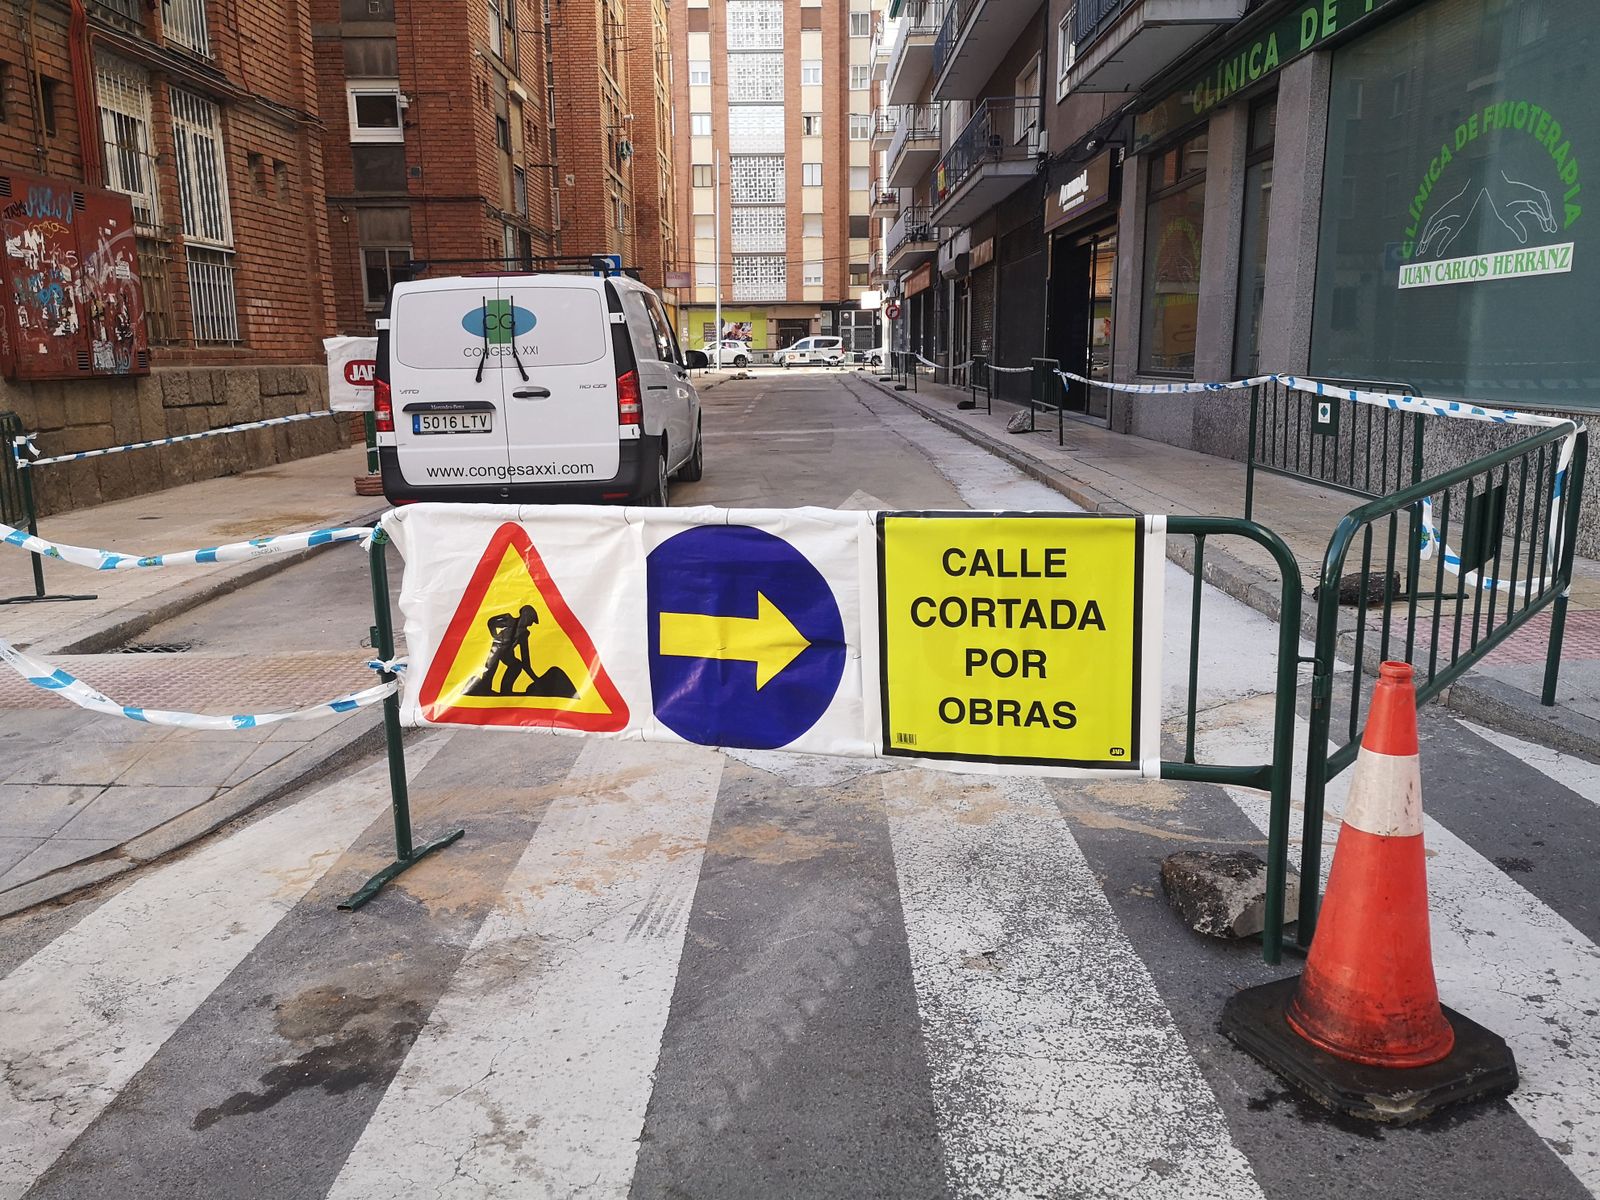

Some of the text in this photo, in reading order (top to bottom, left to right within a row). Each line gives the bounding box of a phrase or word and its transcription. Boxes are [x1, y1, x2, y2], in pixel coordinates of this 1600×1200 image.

[1193, 0, 1337, 114] CLÍNICA DE
[1455, 113, 1480, 151] DE
[1483, 101, 1582, 230] FISIOTERAPIA
[1400, 246, 1571, 286] JUAN CARLOS HERRANZ
[484, 313, 515, 330] CG
[522, 345, 539, 355] XXI
[423, 416, 457, 429] 5016
[462, 415, 487, 428] LTV
[426, 462, 594, 479] www.congesaxxi.com
[942, 548, 1067, 578] CALLE
[910, 596, 1106, 631] CORTADA
[965, 648, 1047, 679] POR
[938, 697, 1077, 729] OBRAS
